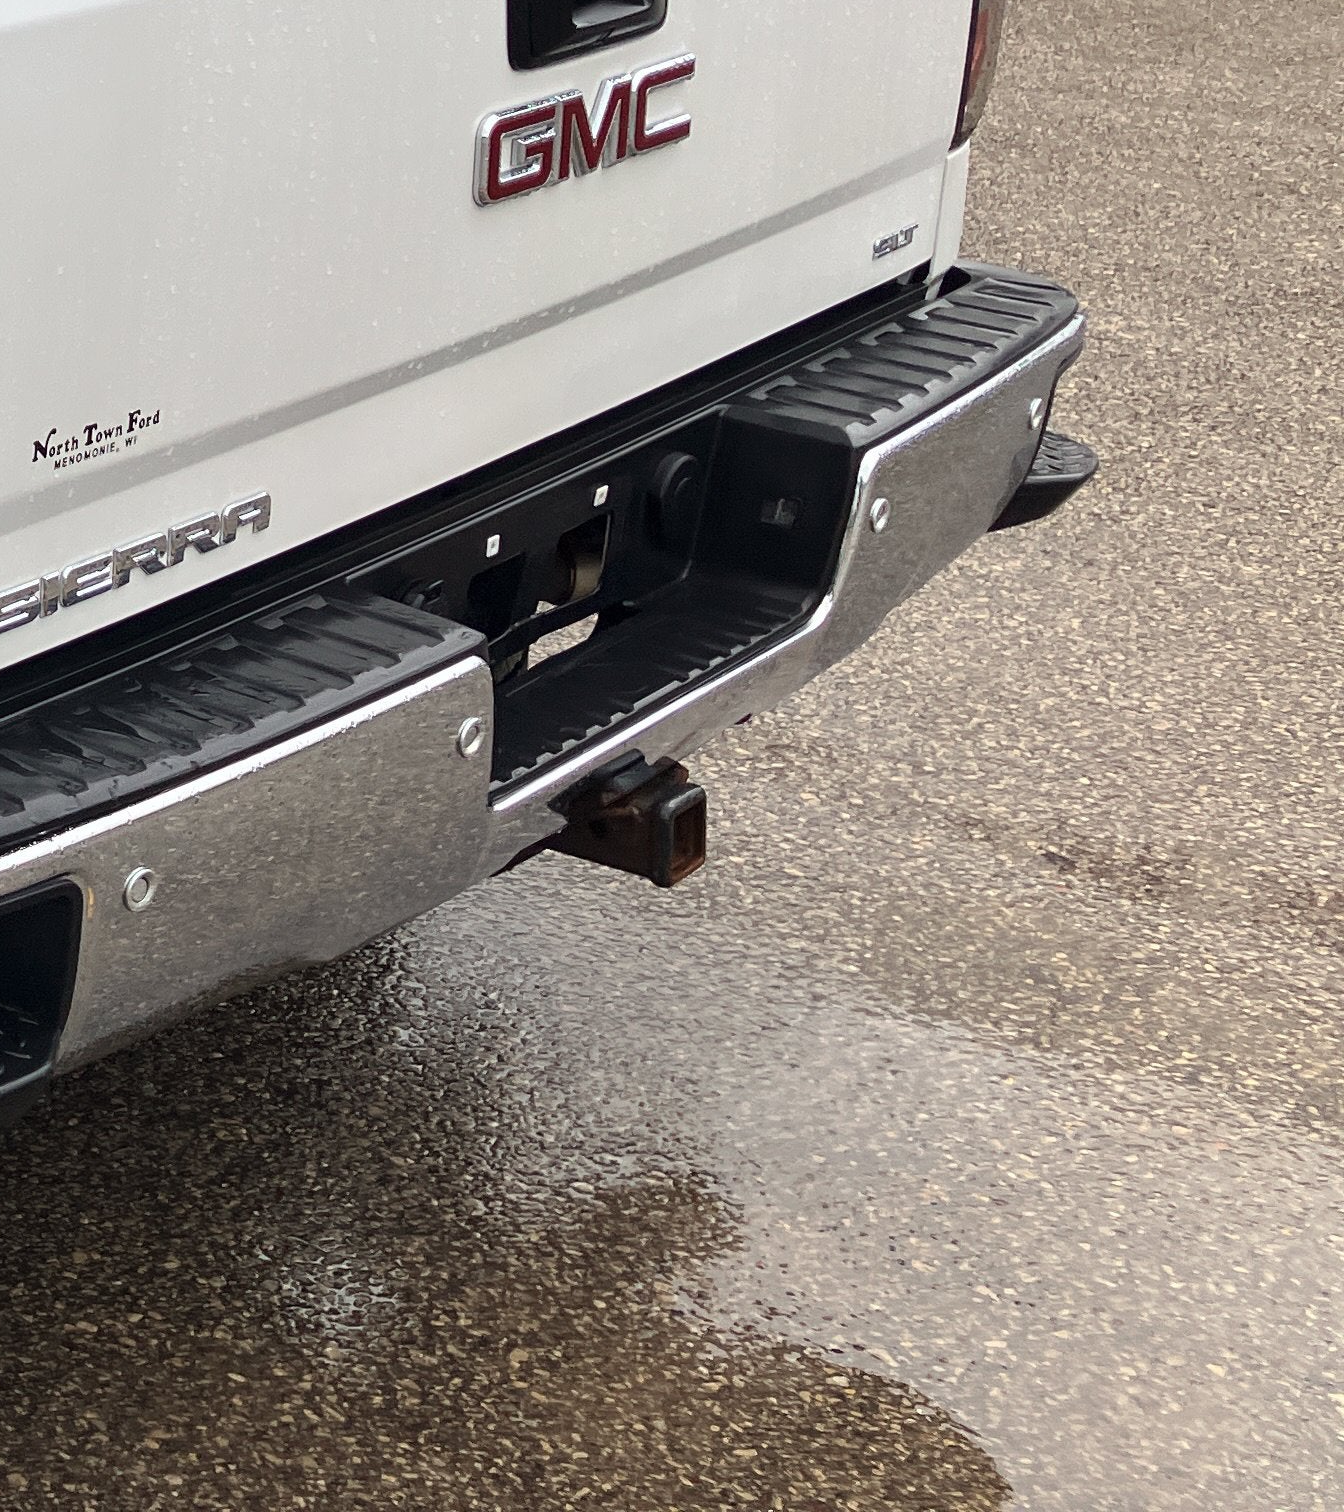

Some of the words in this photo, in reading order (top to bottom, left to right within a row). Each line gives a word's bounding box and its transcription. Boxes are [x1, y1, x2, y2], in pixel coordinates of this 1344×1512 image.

[472, 52, 696, 208] GMC
[31, 427, 79, 463] North
[83, 422, 123, 446] Town
[126, 409, 161, 434] Ford
[124, 435, 138, 448] WI
